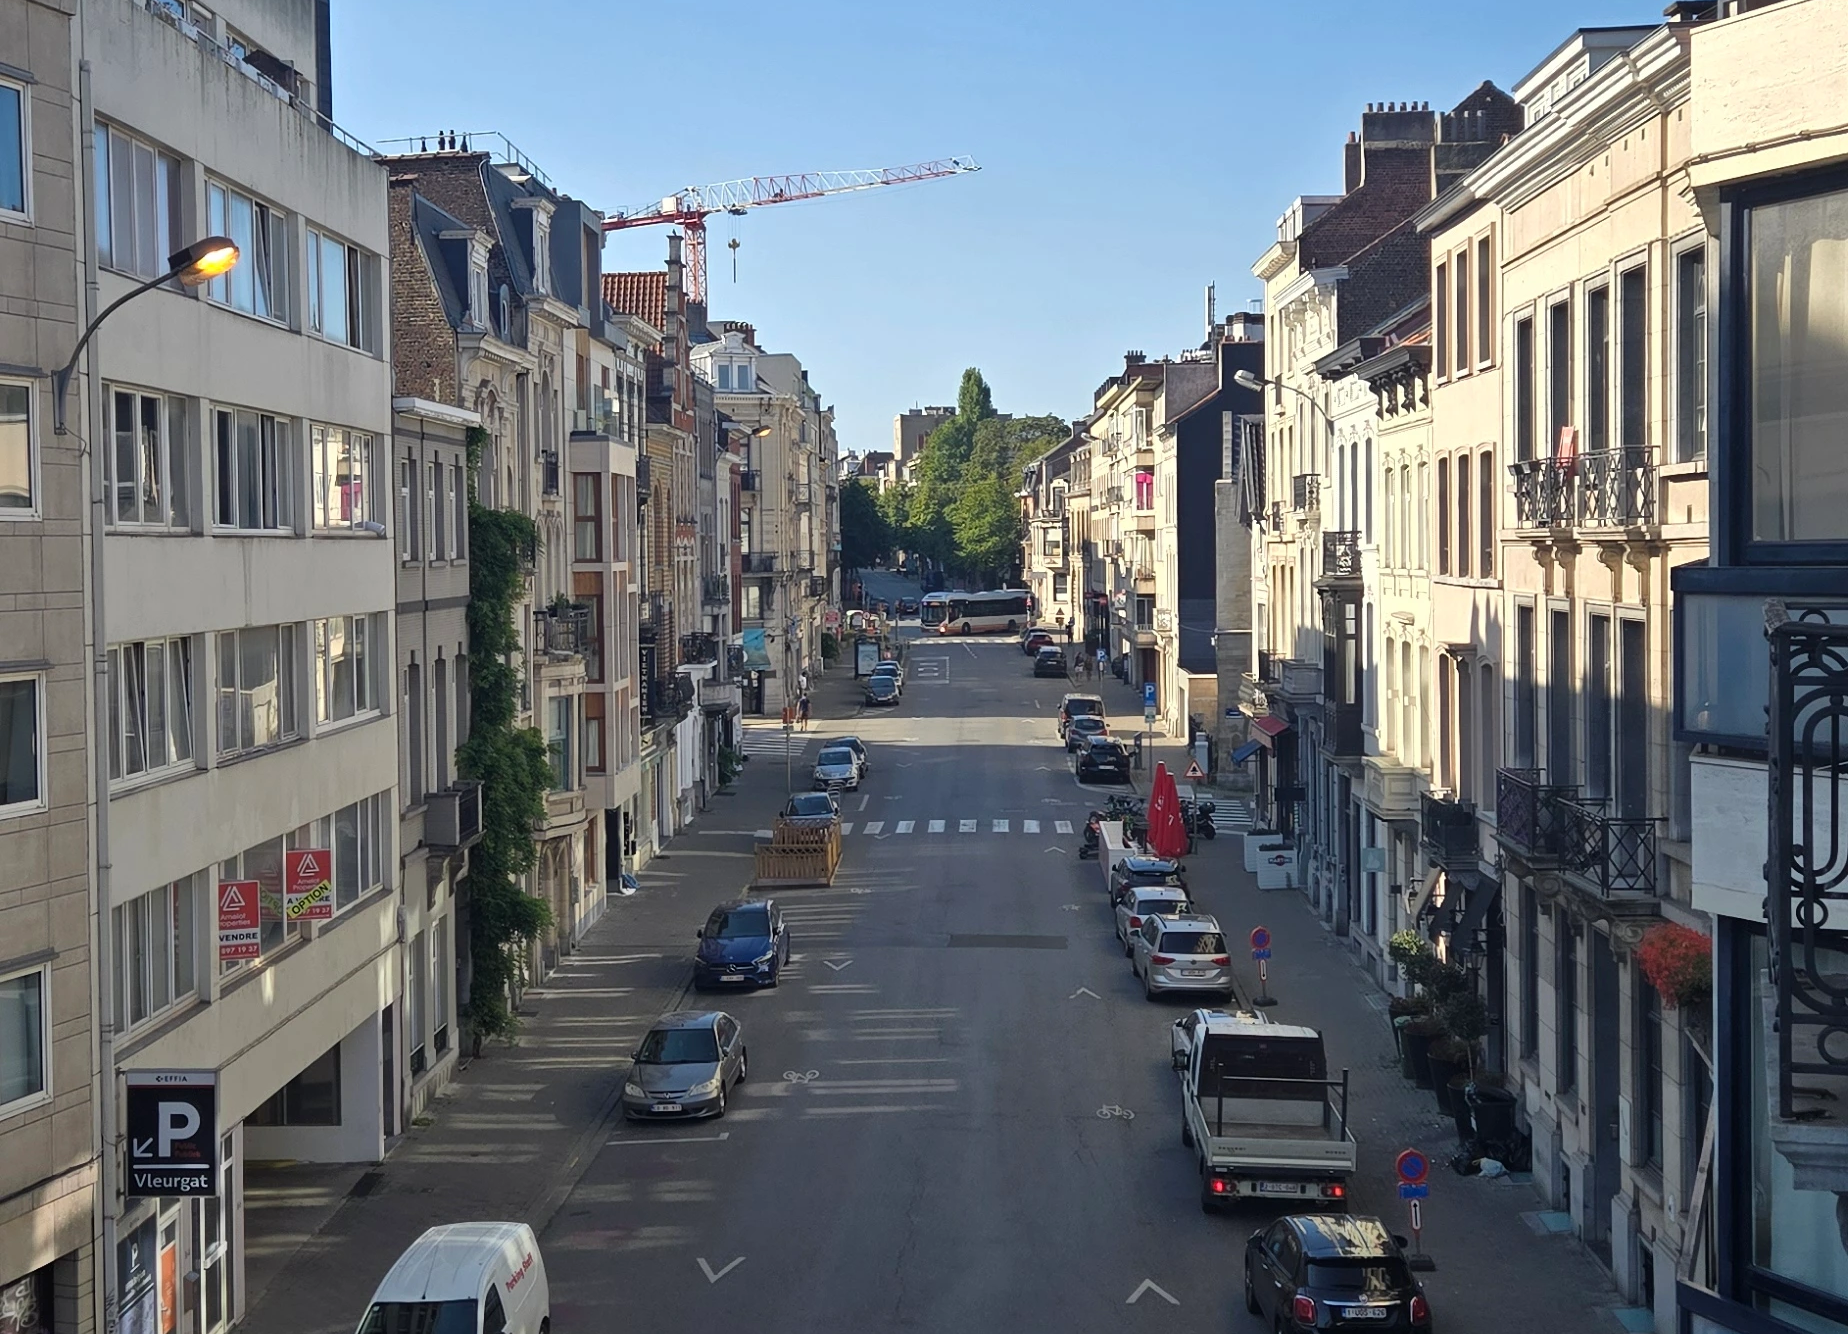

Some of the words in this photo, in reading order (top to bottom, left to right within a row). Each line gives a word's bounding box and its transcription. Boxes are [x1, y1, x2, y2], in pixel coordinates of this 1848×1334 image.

[1145, 685, 1155, 698] P
[292, 884, 329, 914] OPTION
[218, 932, 258, 942] VENDRE
[158, 1101, 201, 1158] P
[133, 1173, 209, 1192] Vleurgat
[505, 1267, 525, 1293] Parking
